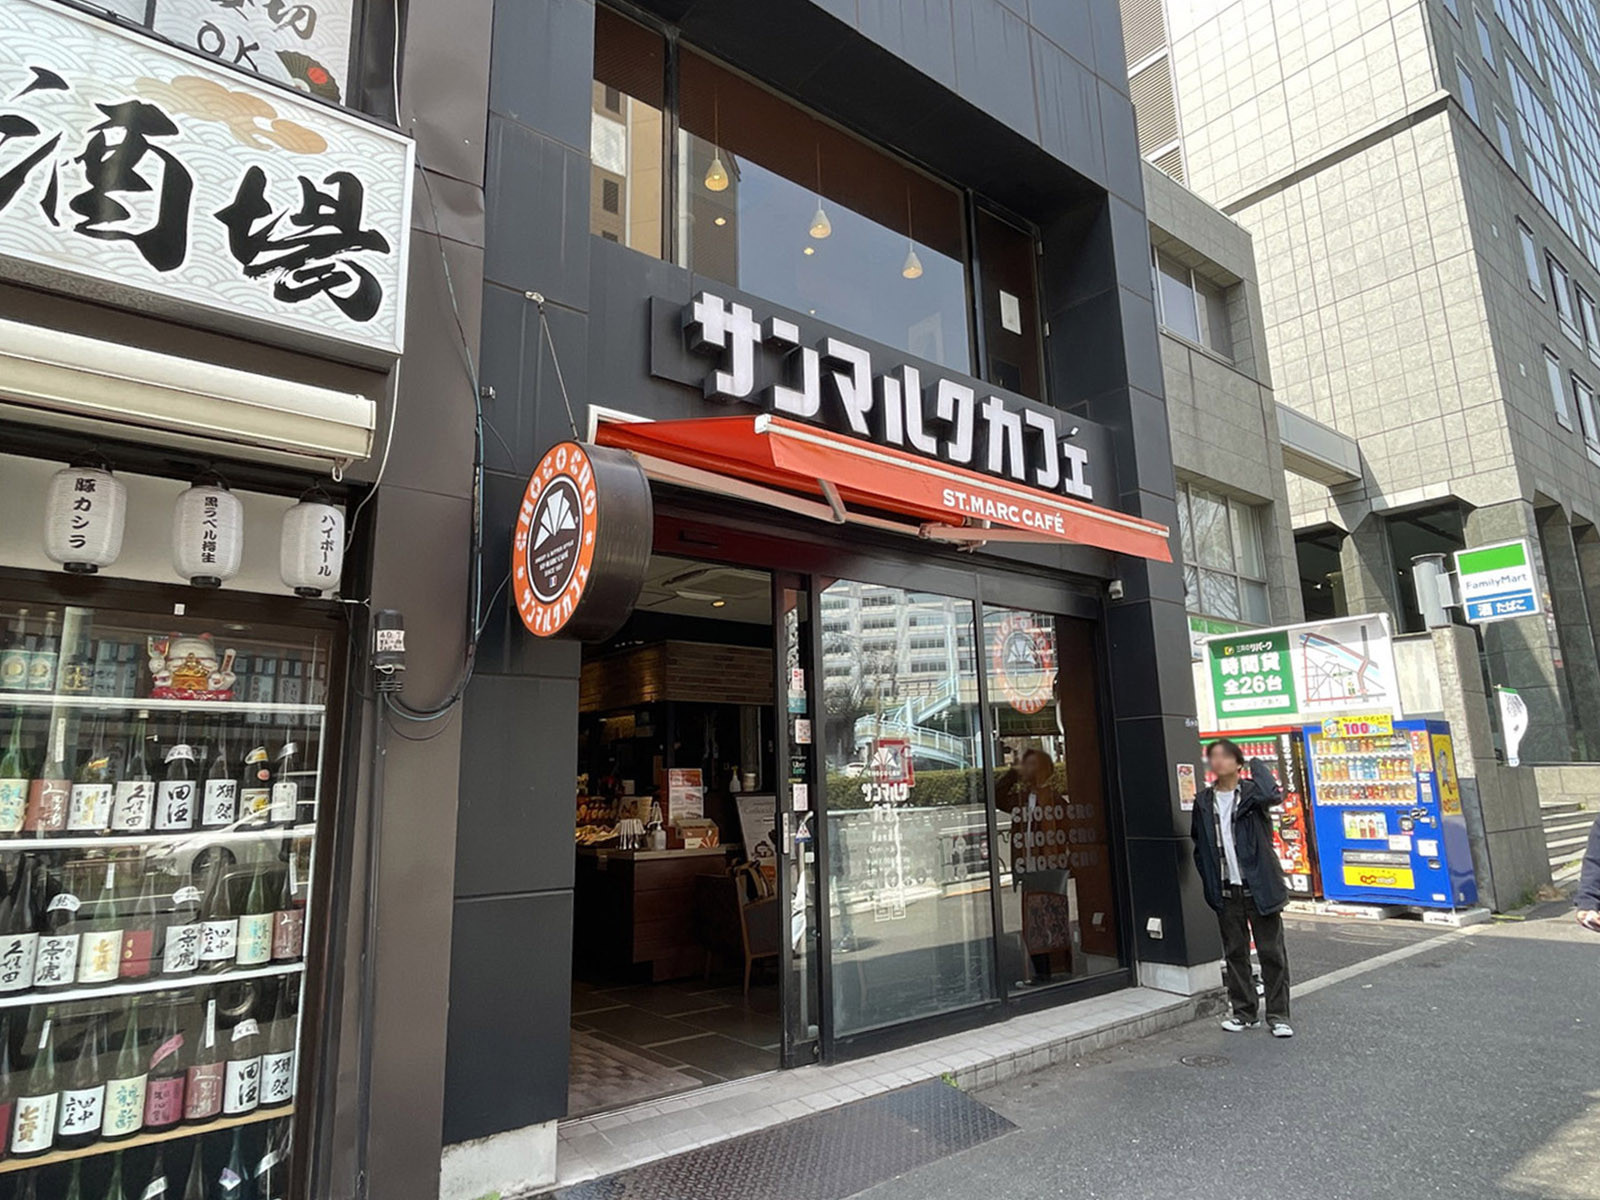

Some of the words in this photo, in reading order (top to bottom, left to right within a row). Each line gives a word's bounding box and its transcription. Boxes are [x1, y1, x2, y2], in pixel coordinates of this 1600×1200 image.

[693, 290, 1093, 500] サンマルクカフェ
[514, 447, 568, 552] CHOCO
[569, 449, 597, 516] CRO
[942, 488, 1020, 523] ST.MARC
[1021, 508, 1066, 534] CAFÉ
[69, 477, 97, 549] 豚カシラ
[317, 514, 336, 577] ハイボール
[1465, 573, 1527, 590] FamilyMart
[521, 563, 590, 633] サンマルクカフェ
[1496, 598, 1528, 614] たばこ
[1220, 651, 1281, 676] 時間貸
[1223, 674, 1283, 696] 全26台
[861, 782, 910, 803] サンマルク
[1011, 804, 1064, 823] CHOCO
[1013, 828, 1066, 849] CHOCO
[1015, 853, 1068, 874] CHOCO
